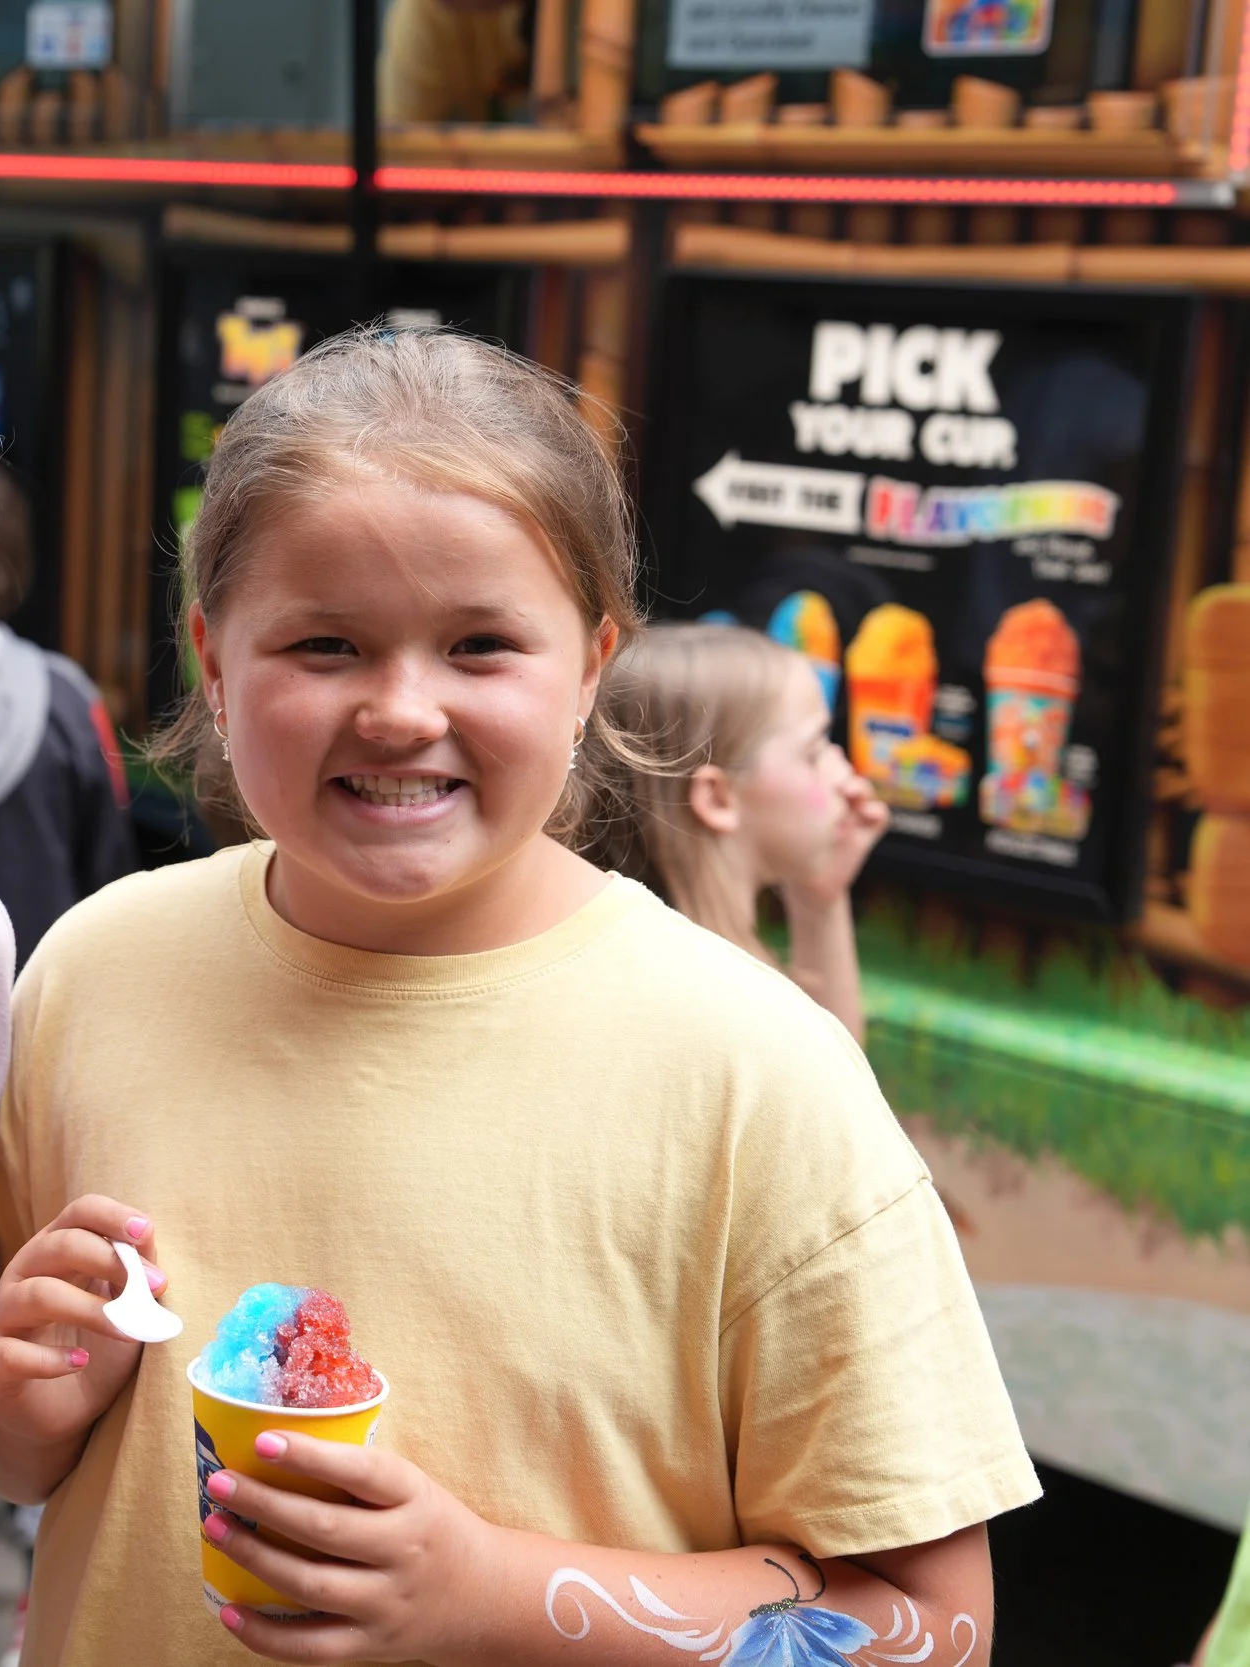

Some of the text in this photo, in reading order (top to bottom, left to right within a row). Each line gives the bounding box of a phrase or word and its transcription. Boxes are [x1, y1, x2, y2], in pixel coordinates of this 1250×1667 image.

[810, 320, 1003, 414] PICK
[788, 400, 915, 462] YOUR
[796, 485, 841, 511] THE
